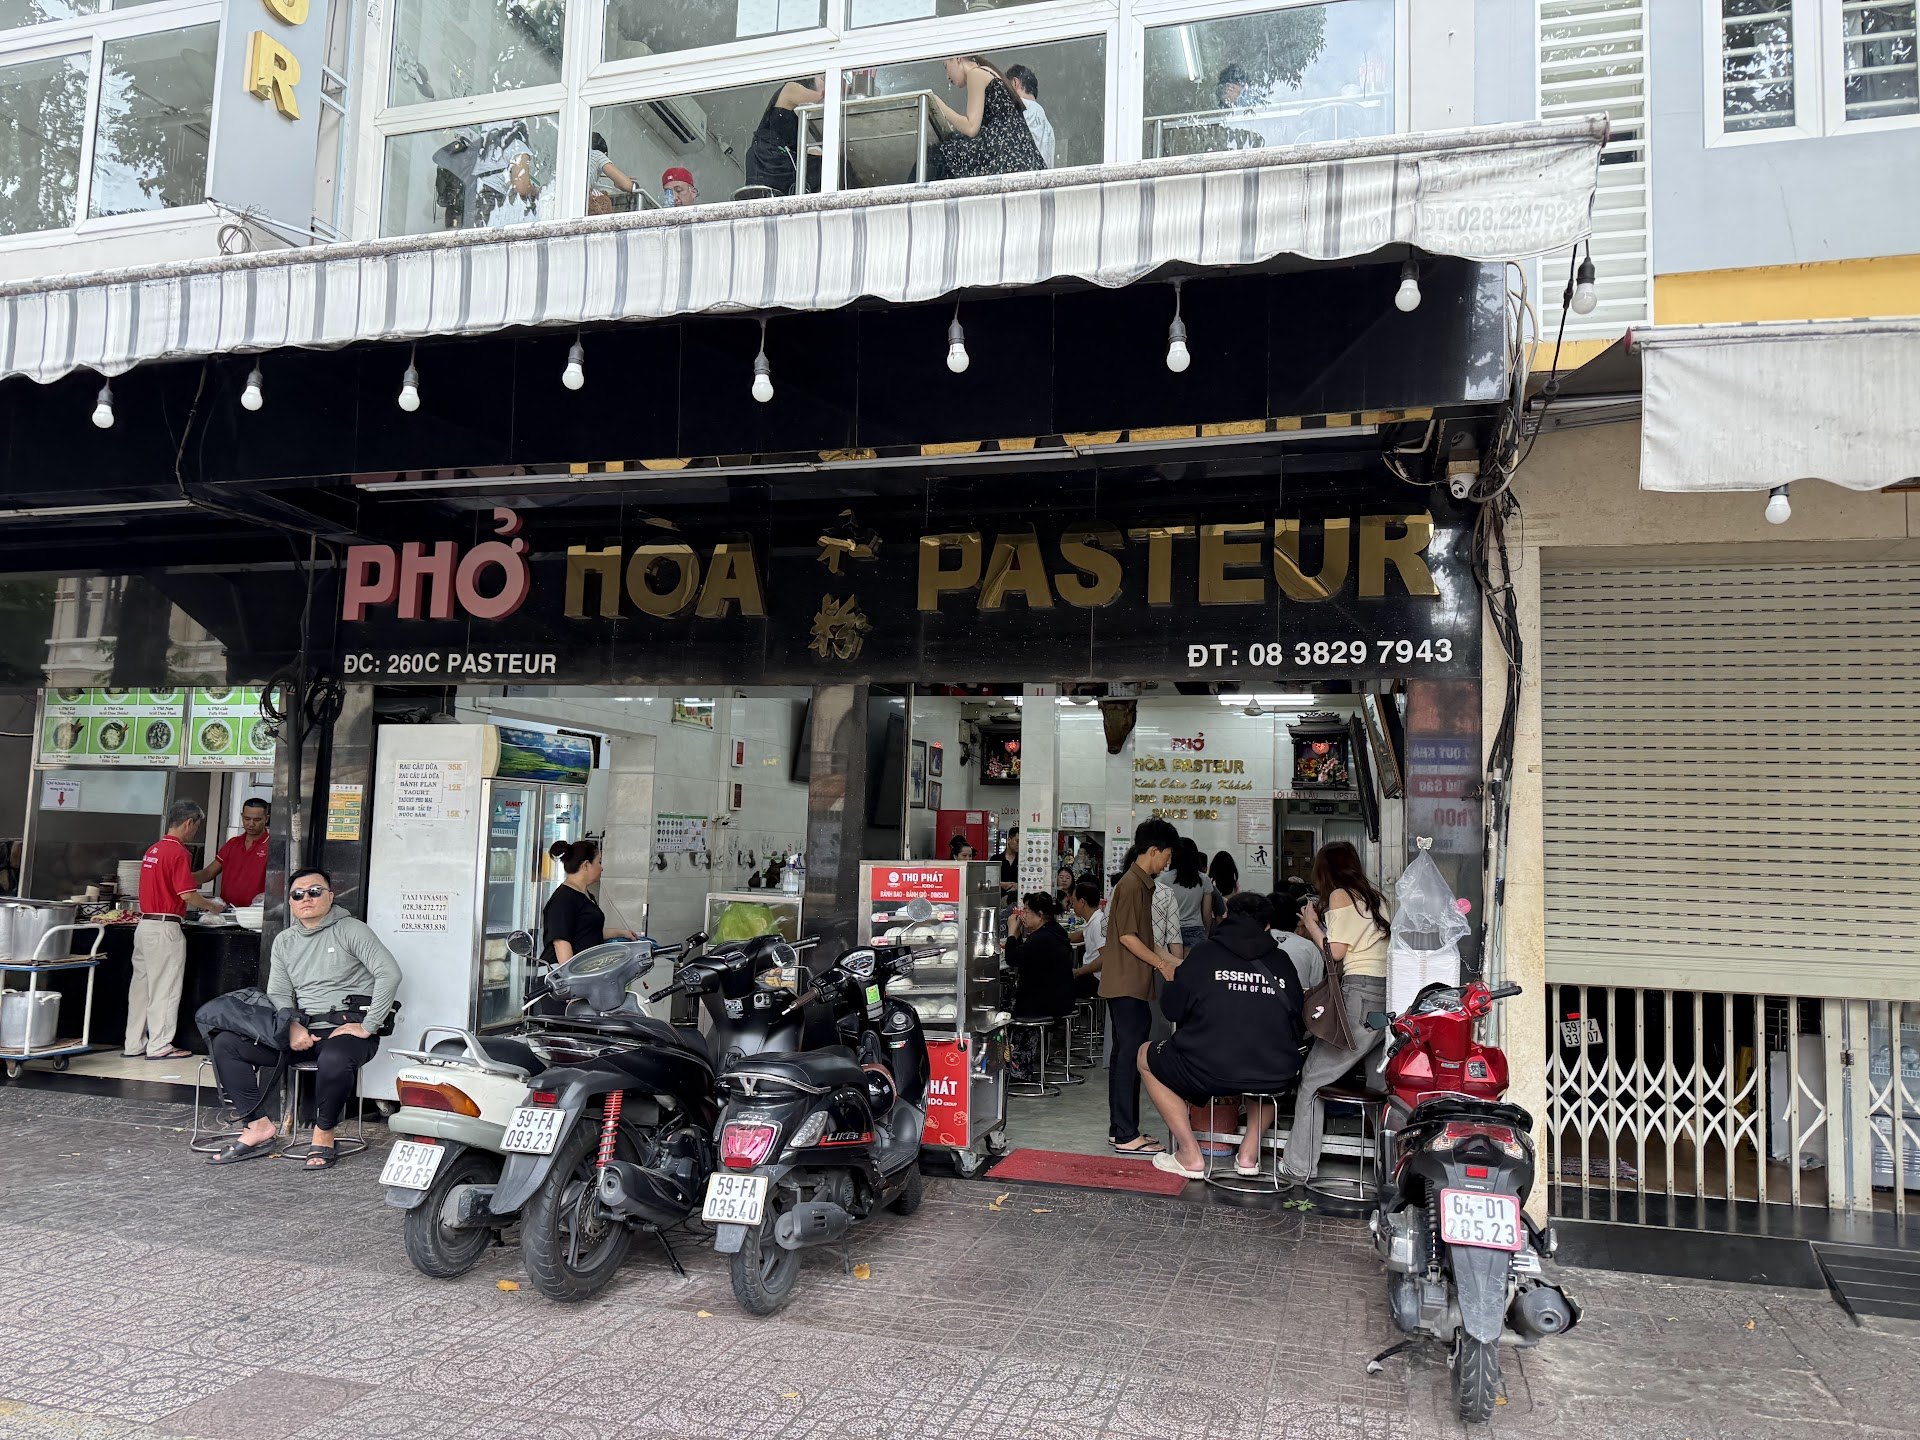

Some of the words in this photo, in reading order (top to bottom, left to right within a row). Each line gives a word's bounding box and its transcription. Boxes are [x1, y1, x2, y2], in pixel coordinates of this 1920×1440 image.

[250, 0, 310, 121] R
[342, 507, 530, 622] PHỞ
[564, 510, 767, 619] HÒA
[917, 508, 1441, 612] PASTEUR
[344, 653, 381, 674] ĐC:
[386, 652, 440, 673] 260C
[447, 653, 557, 674] PASTEUR
[1188, 642, 1239, 668] ĐT:
[1248, 641, 1283, 667] 08
[1294, 640, 1367, 666] 3829
[1376, 638, 1453, 664] 7943
[1171, 759, 1245, 774] PASTEUR
[1031, 812, 1041, 823] 11
[1151, 808, 1188, 820] SINCE
[902, 872, 918, 885] THỌ
[920, 870, 944, 883] PHÁT
[905, 890, 918, 898] BÁNH
[1215, 970, 1286, 989] ESSENTIS
[1228, 982, 1247, 992] FEAR
[1250, 985, 1259, 993] OF
[405, 1073, 430, 1082] HONDA
[929, 1076, 958, 1096] HÁT
[516, 1110, 556, 1130] 59-FA
[505, 1129, 553, 1150] 093.23
[397, 1144, 436, 1166] 59-D1
[385, 1163, 433, 1187] 182.65
[716, 1176, 757, 1199] 59-FA
[708, 1197, 758, 1221] 035.40
[1453, 1194, 1505, 1220] 64-D1
